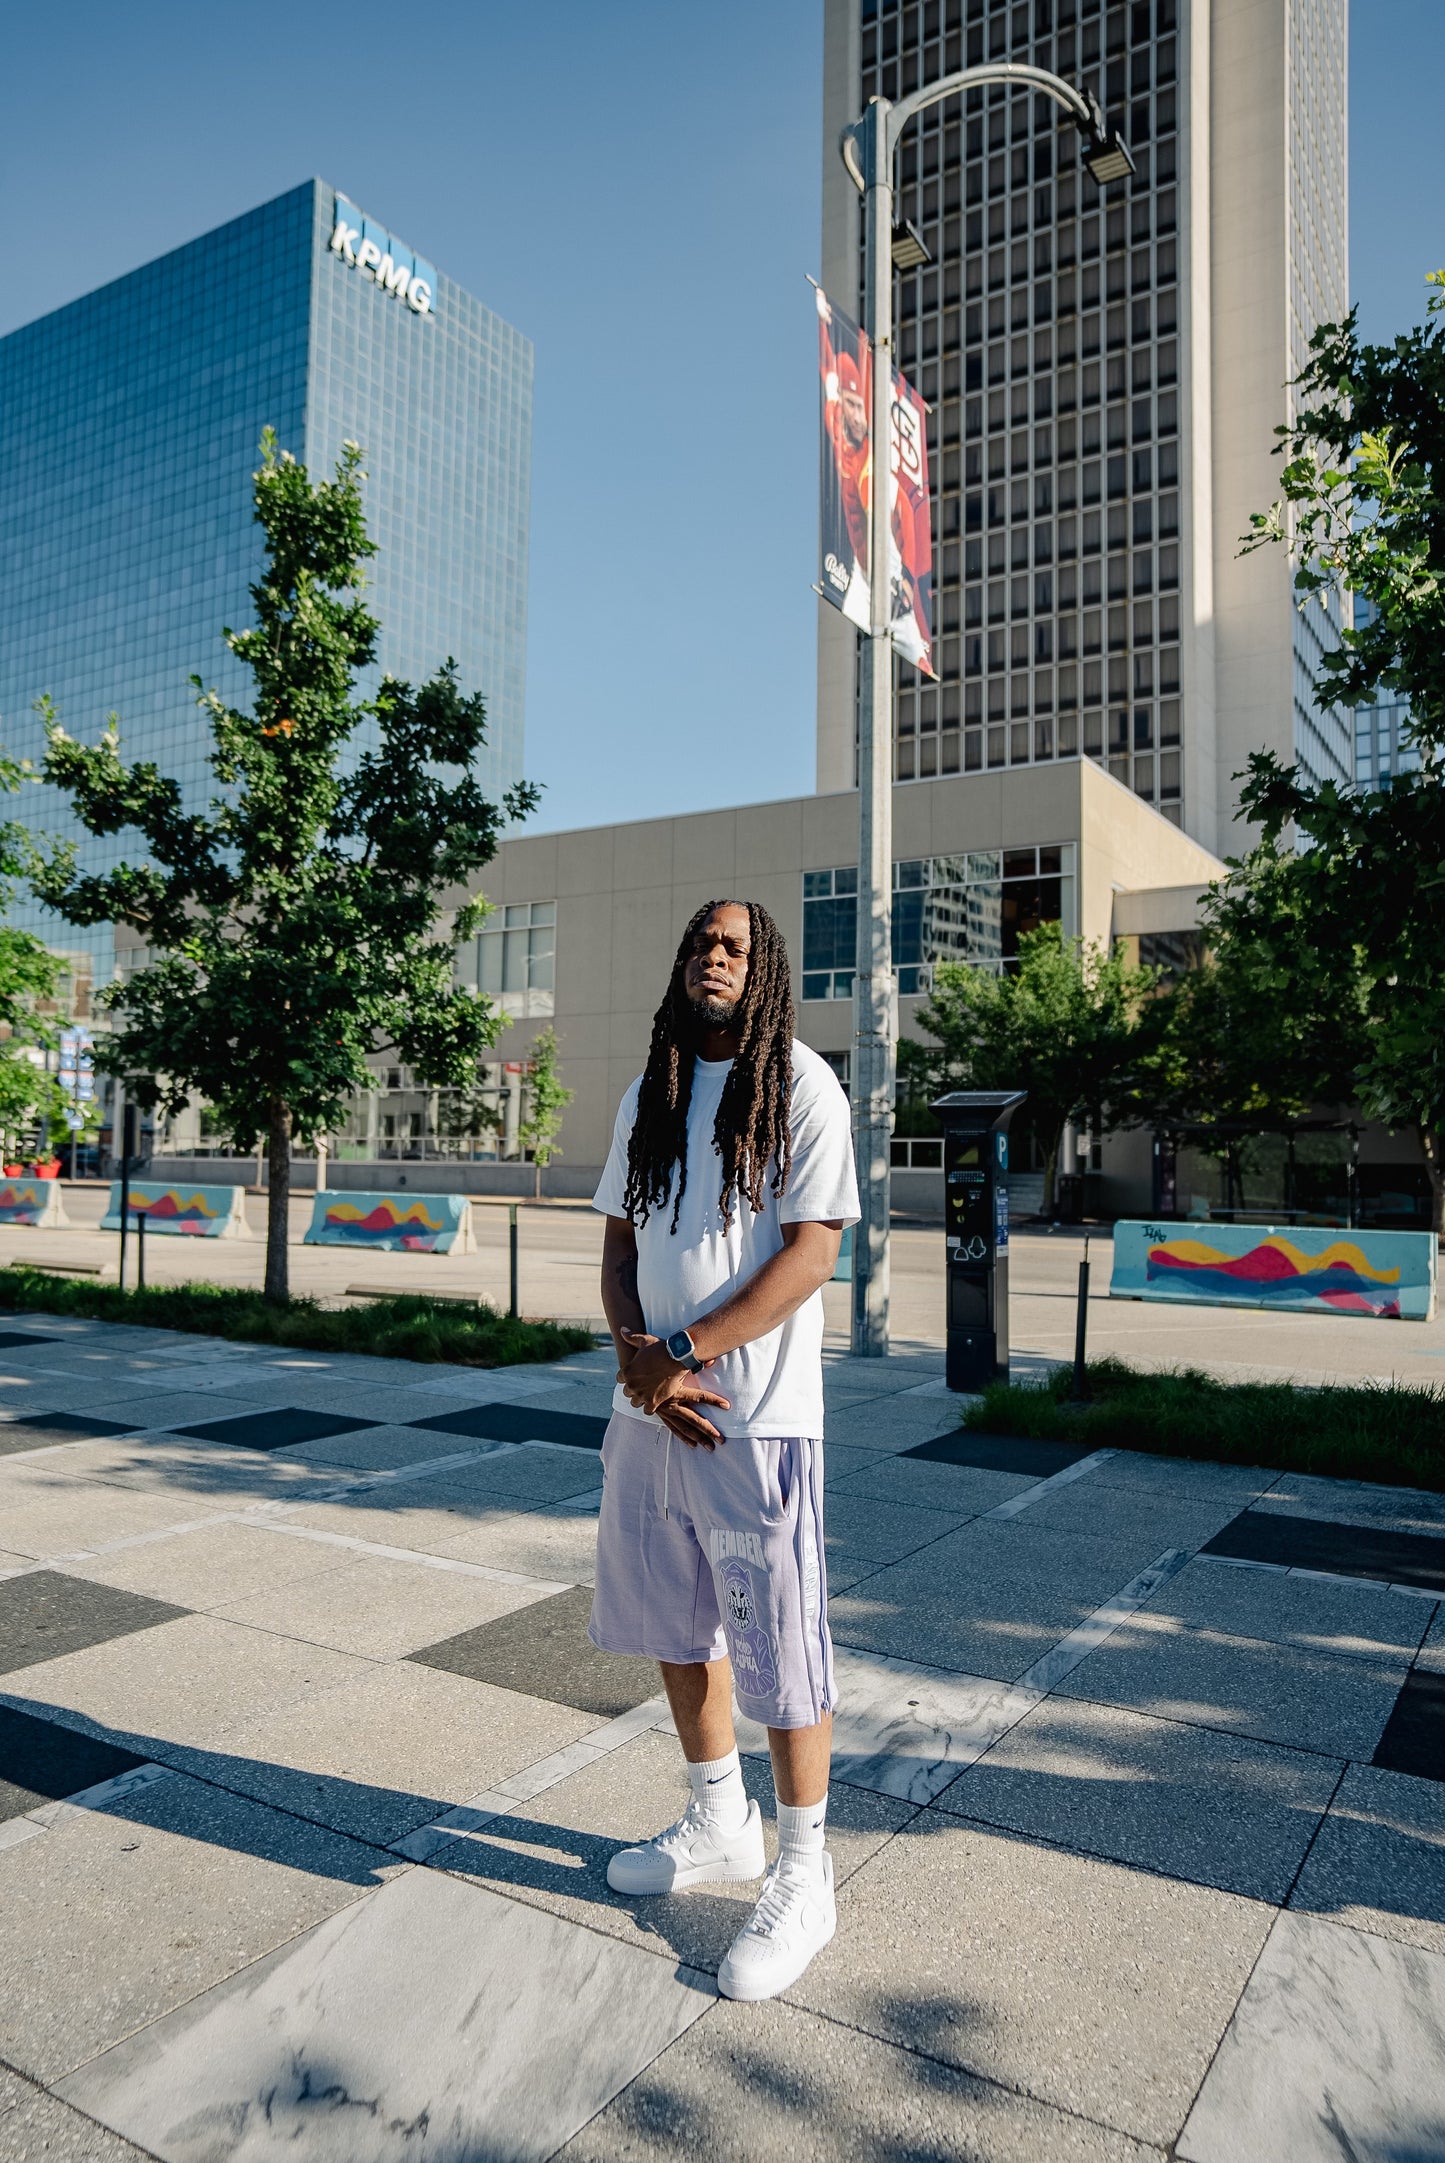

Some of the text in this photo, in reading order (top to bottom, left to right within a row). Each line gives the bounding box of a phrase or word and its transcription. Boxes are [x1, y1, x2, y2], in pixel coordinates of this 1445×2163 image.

[331, 221, 432, 313] KPMG
[998, 1136, 1007, 1162] P
[710, 1529, 769, 1572] MEMBER
